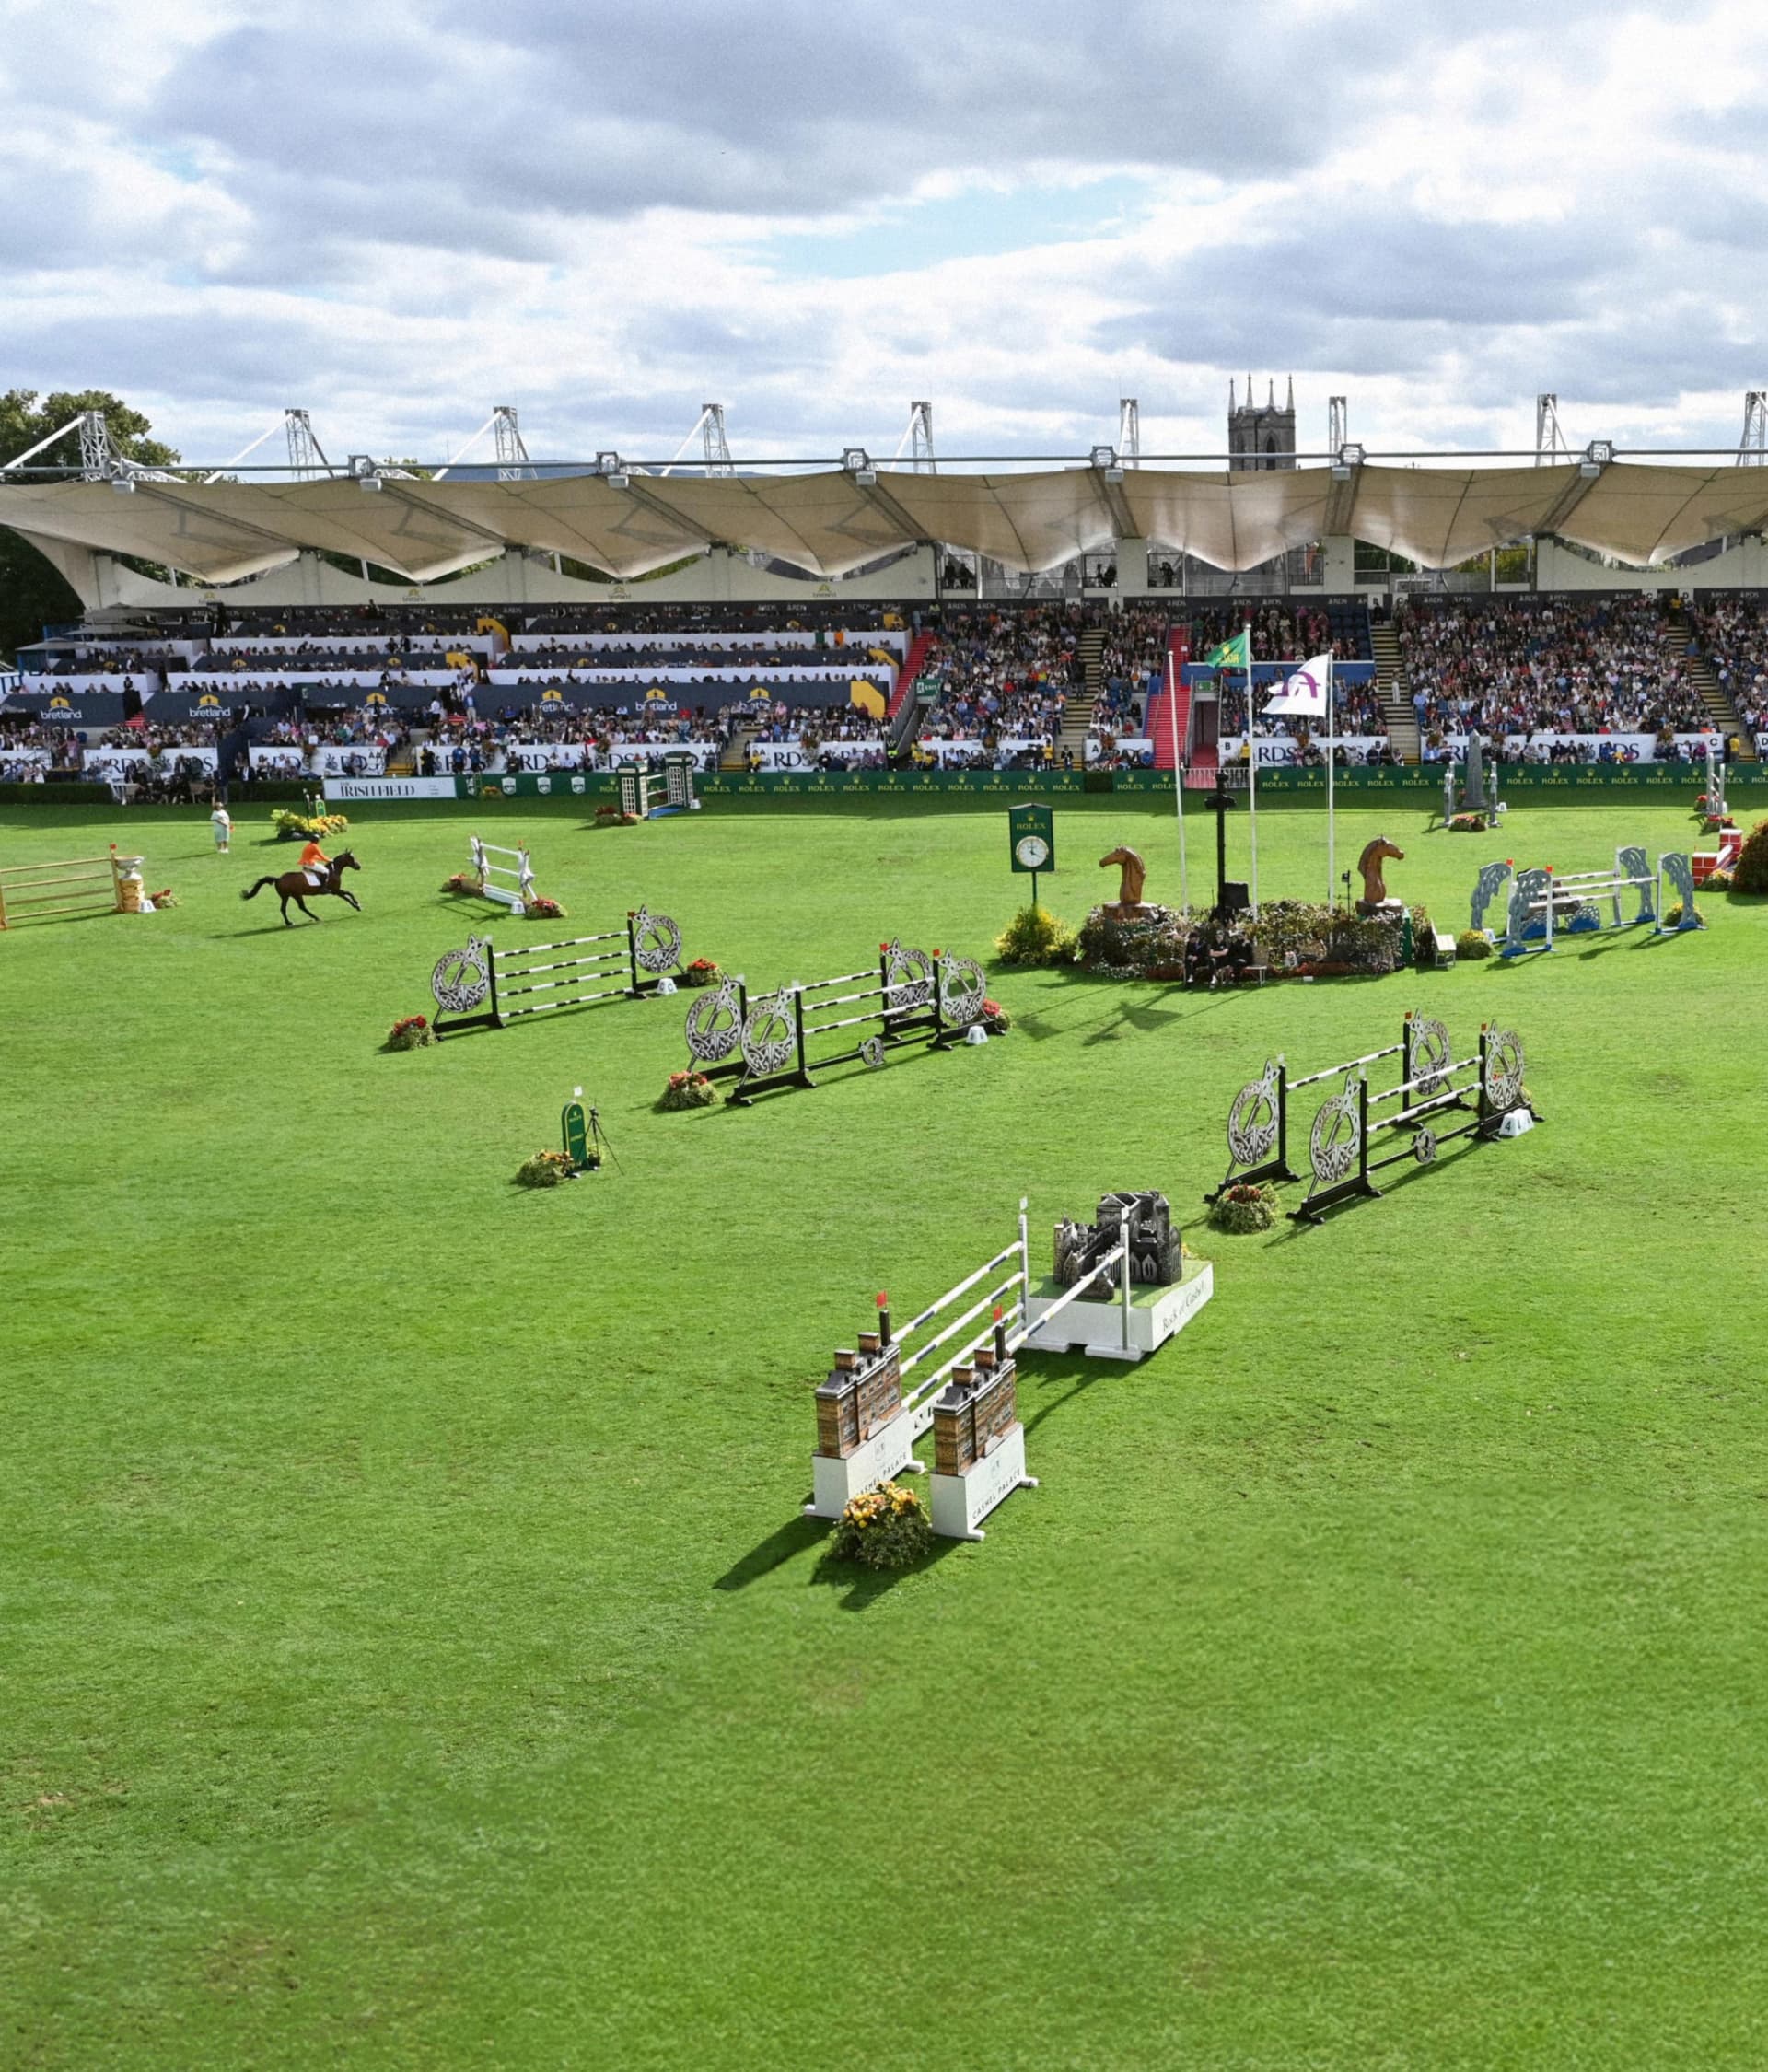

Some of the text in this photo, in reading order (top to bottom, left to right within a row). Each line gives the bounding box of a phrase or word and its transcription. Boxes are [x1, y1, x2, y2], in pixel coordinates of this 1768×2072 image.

[636, 702, 677, 711] btland
[41, 710, 82, 720] bretland
[189, 708, 231, 717] bretland
[1259, 746, 1295, 762] RDS
[341, 786, 414, 797] IRISH FIELD
[1505, 1120, 1511, 1132] 4
[883, 1452, 906, 1475] PALACE
[972, 1468, 1020, 1519] CASHEL PALACE
